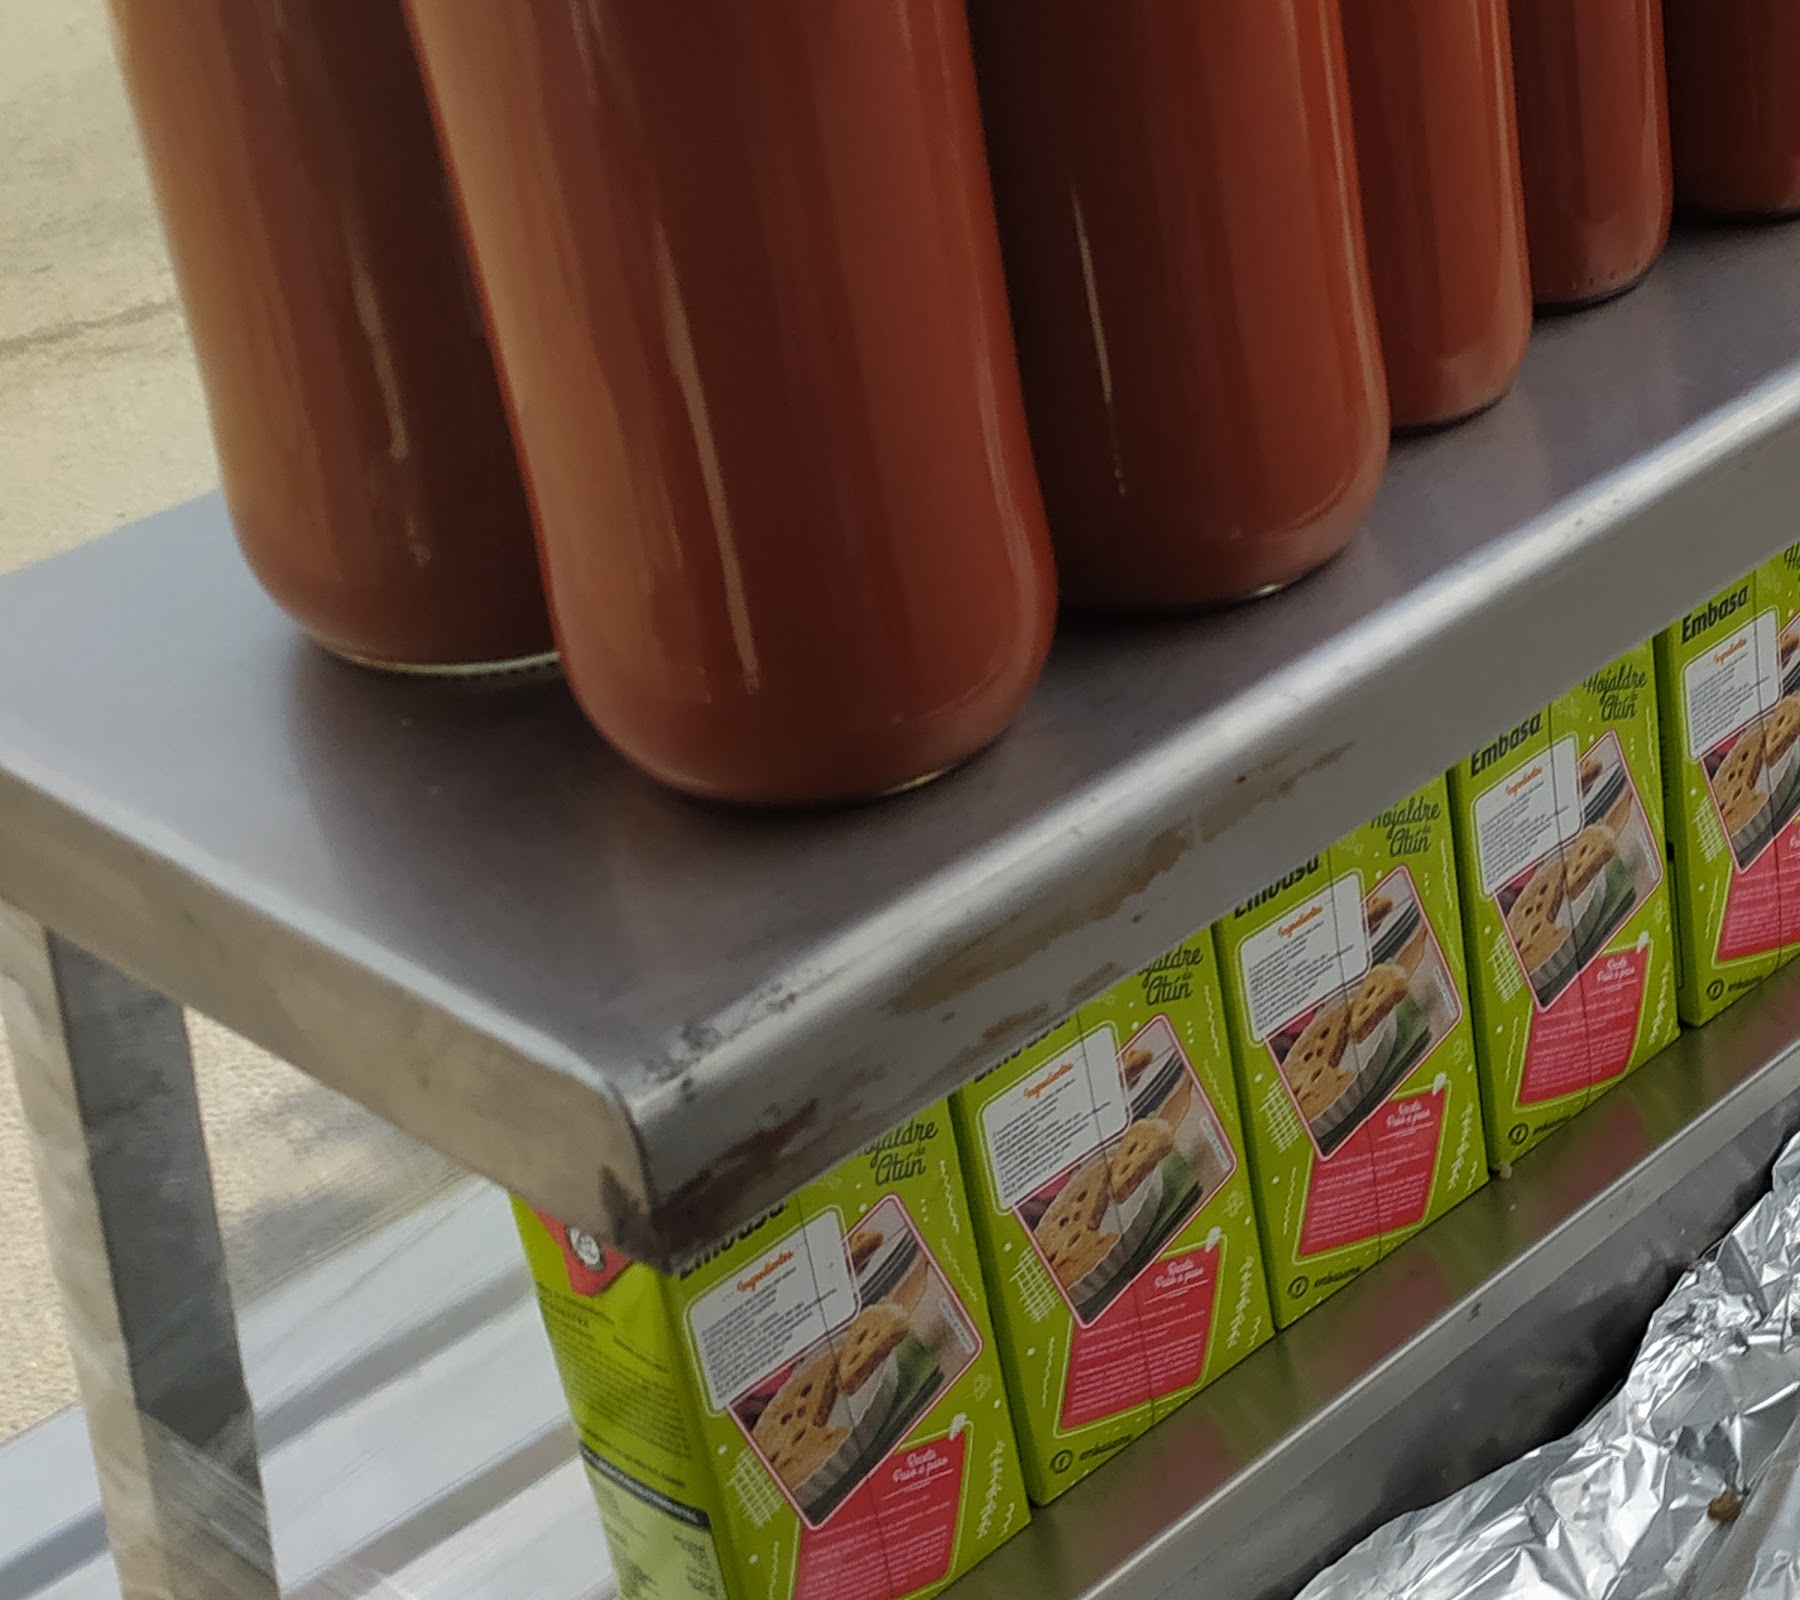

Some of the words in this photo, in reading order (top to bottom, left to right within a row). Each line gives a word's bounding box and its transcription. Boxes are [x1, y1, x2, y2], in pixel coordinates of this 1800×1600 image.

[1681, 585, 1748, 644] Embasa
[1583, 664, 1647, 705] Hojaldre
[1471, 713, 1542, 778] Embasa
